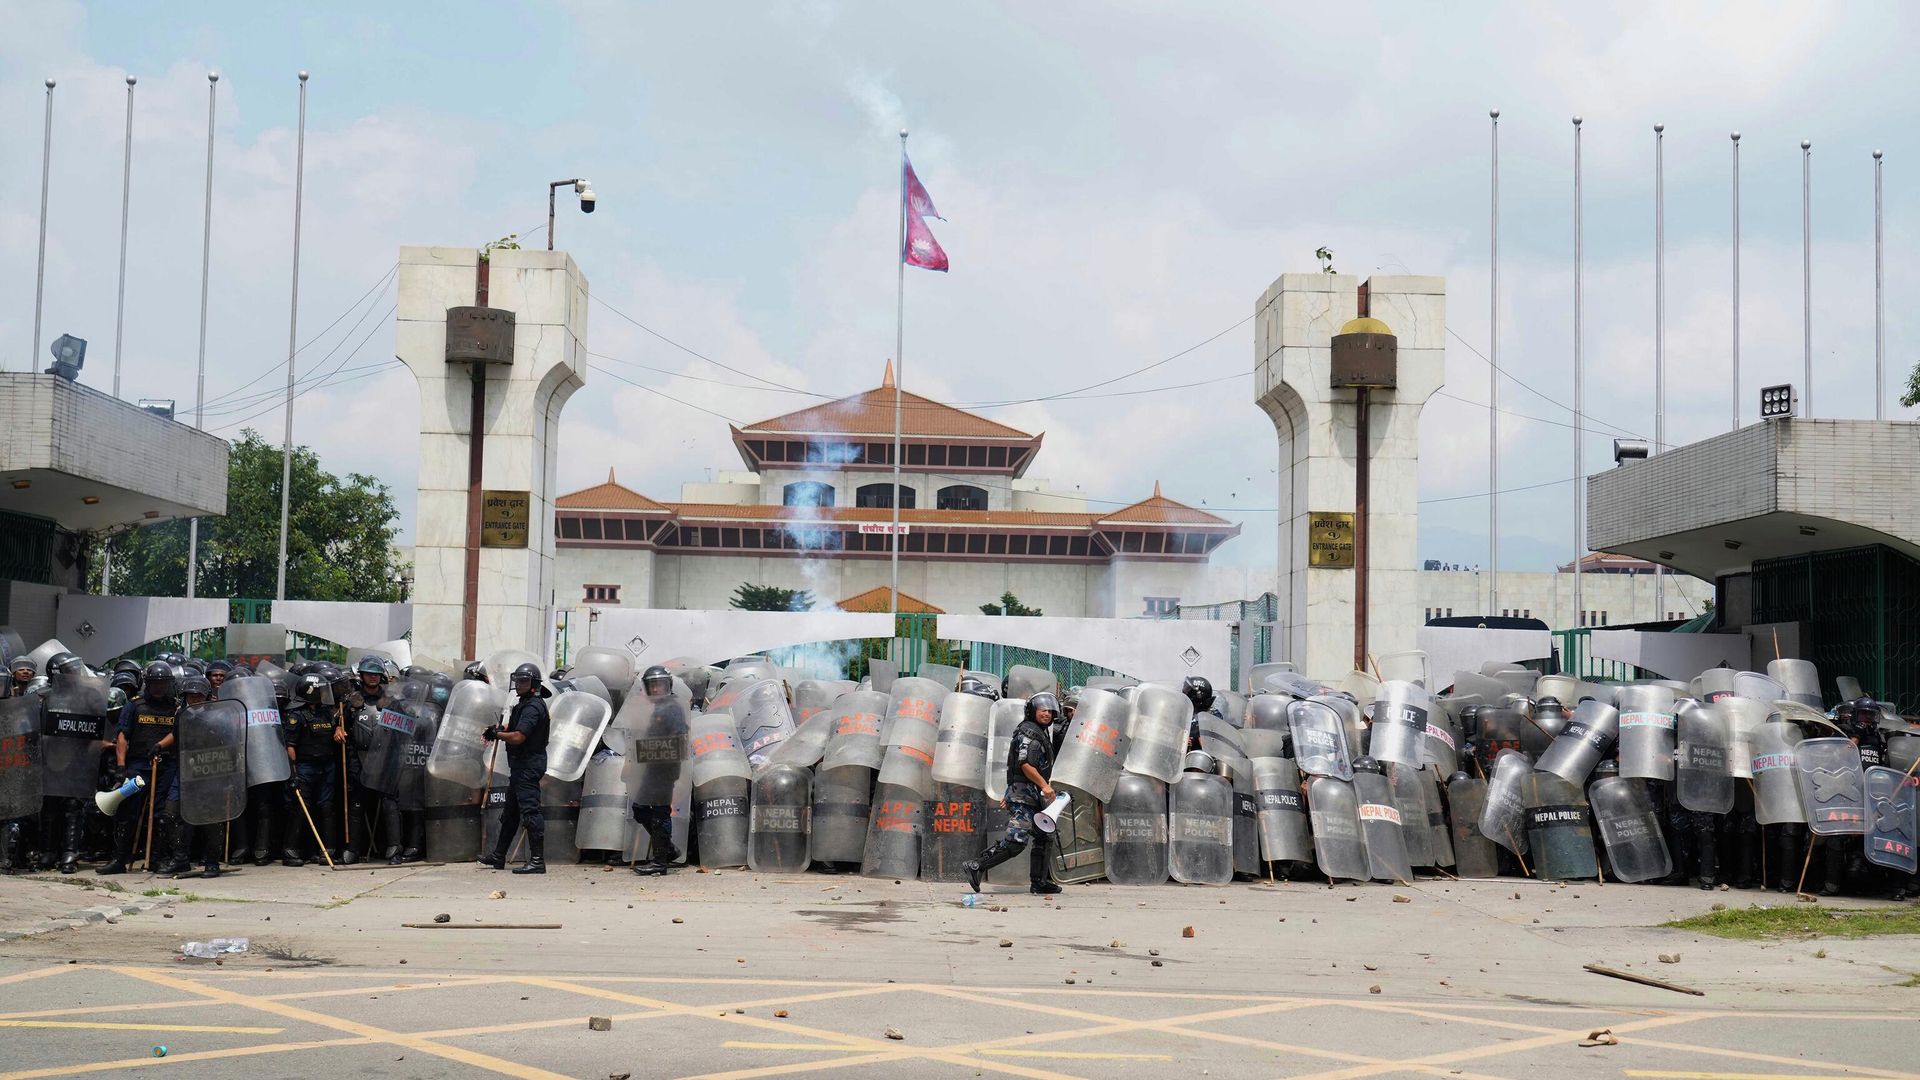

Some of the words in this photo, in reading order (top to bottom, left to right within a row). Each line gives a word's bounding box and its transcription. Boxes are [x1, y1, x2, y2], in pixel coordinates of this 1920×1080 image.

[485, 521, 511, 529] ENTRANCE
[252, 711, 280, 723] POLICE
[1387, 707, 1416, 723] PLICE
[382, 711, 403, 730] NEPAL
[1621, 714, 1644, 724] NEPAL
[1647, 714, 1673, 727] POLICE
[58, 719, 77, 732] NEPAL
[78, 721, 97, 733] POLICE
[1569, 725, 1583, 735] NEPAL
[641, 740, 675, 750] NEPAL
[640, 750, 678, 760] POLICE
[1693, 746, 1721, 756] NEPAL
[1861, 749, 1879, 757] NEPAL
[196, 751, 231, 764] NEPAL
[1692, 757, 1722, 767] POLICE
[1861, 756, 1880, 764] POLICE
[193, 761, 234, 775] POLICE
[1753, 756, 1777, 770] NEPAL
[706, 799, 737, 808] NEPAL
[1264, 795, 1281, 804] NEPAL
[1281, 796, 1298, 806] POLICE
[706, 808, 739, 817] POLICE
[766, 808, 797, 818] NEPAL
[1360, 807, 1383, 818] NEPAL
[1534, 812, 1557, 822] NEPAL
[1558, 811, 1581, 821] POLICE
[763, 819, 799, 829] POLICE
[934, 819, 975, 833] NEPAL
[1119, 818, 1152, 827] NEPAL
[1186, 818, 1217, 828] NEPAL
[1614, 819, 1645, 830] NEPAL
[1119, 828, 1153, 837] POLICE
[1184, 828, 1218, 838] POLICE
[1616, 826, 1649, 838] POLICE
